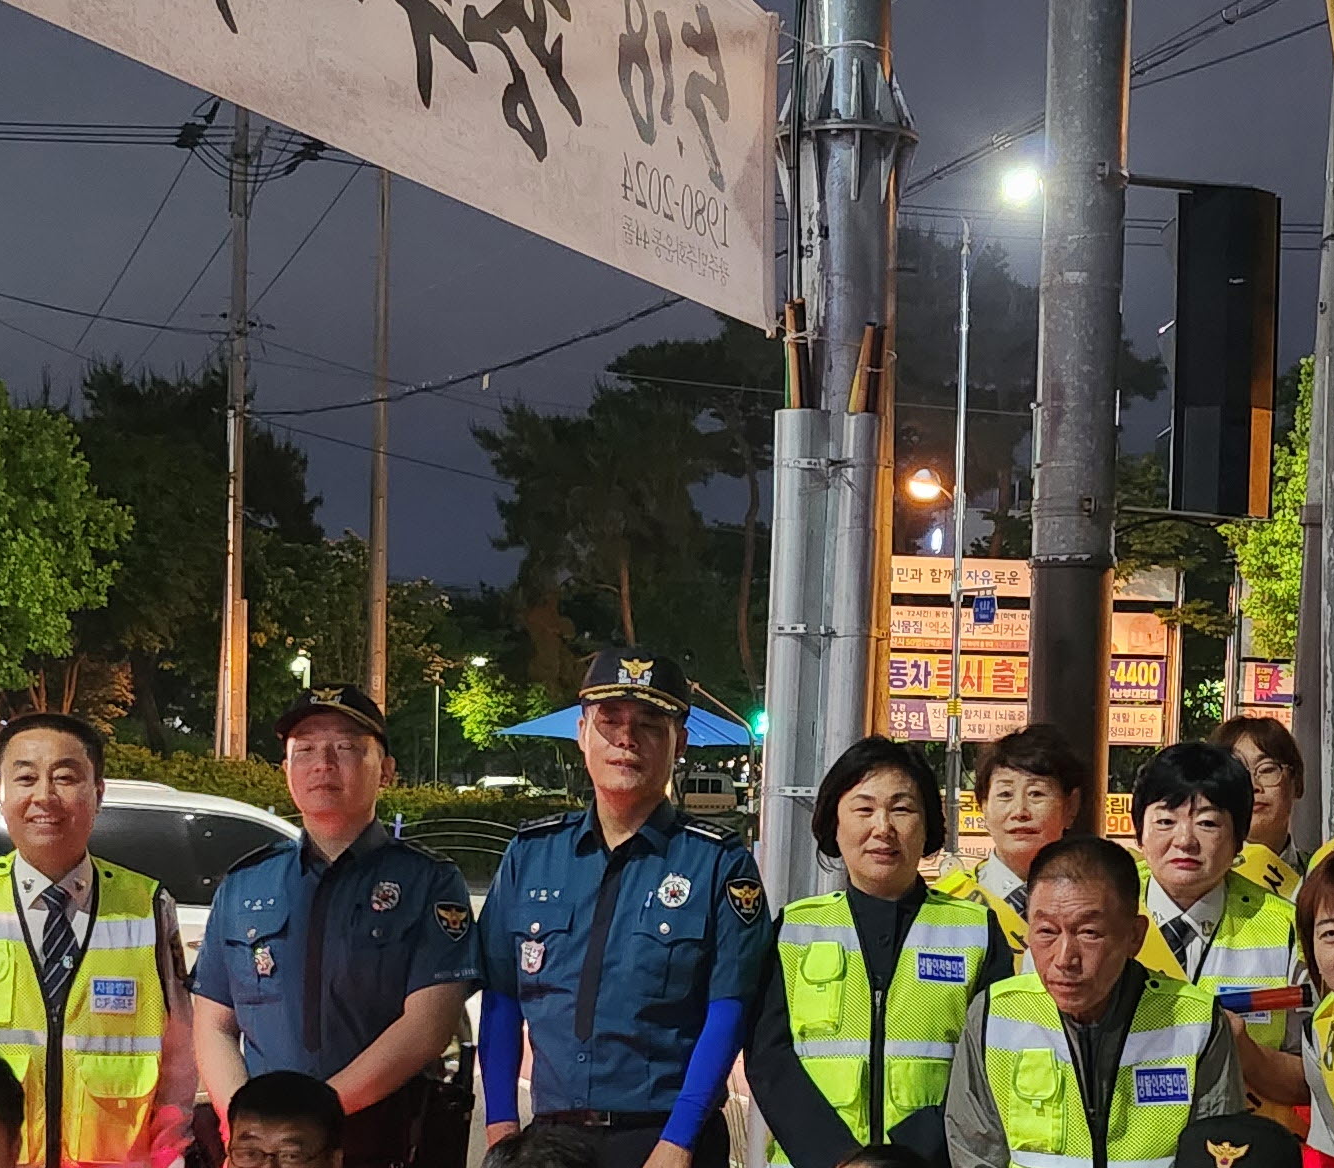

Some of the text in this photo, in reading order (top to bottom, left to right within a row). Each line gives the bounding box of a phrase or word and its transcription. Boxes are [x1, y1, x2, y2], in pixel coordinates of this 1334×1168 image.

[891, 567, 923, 583] 민과
[966, 569, 1021, 586] 자유로운
[918, 956, 965, 980] 생활안전협의회
[1138, 1074, 1188, 1098] 생활안전협의회
